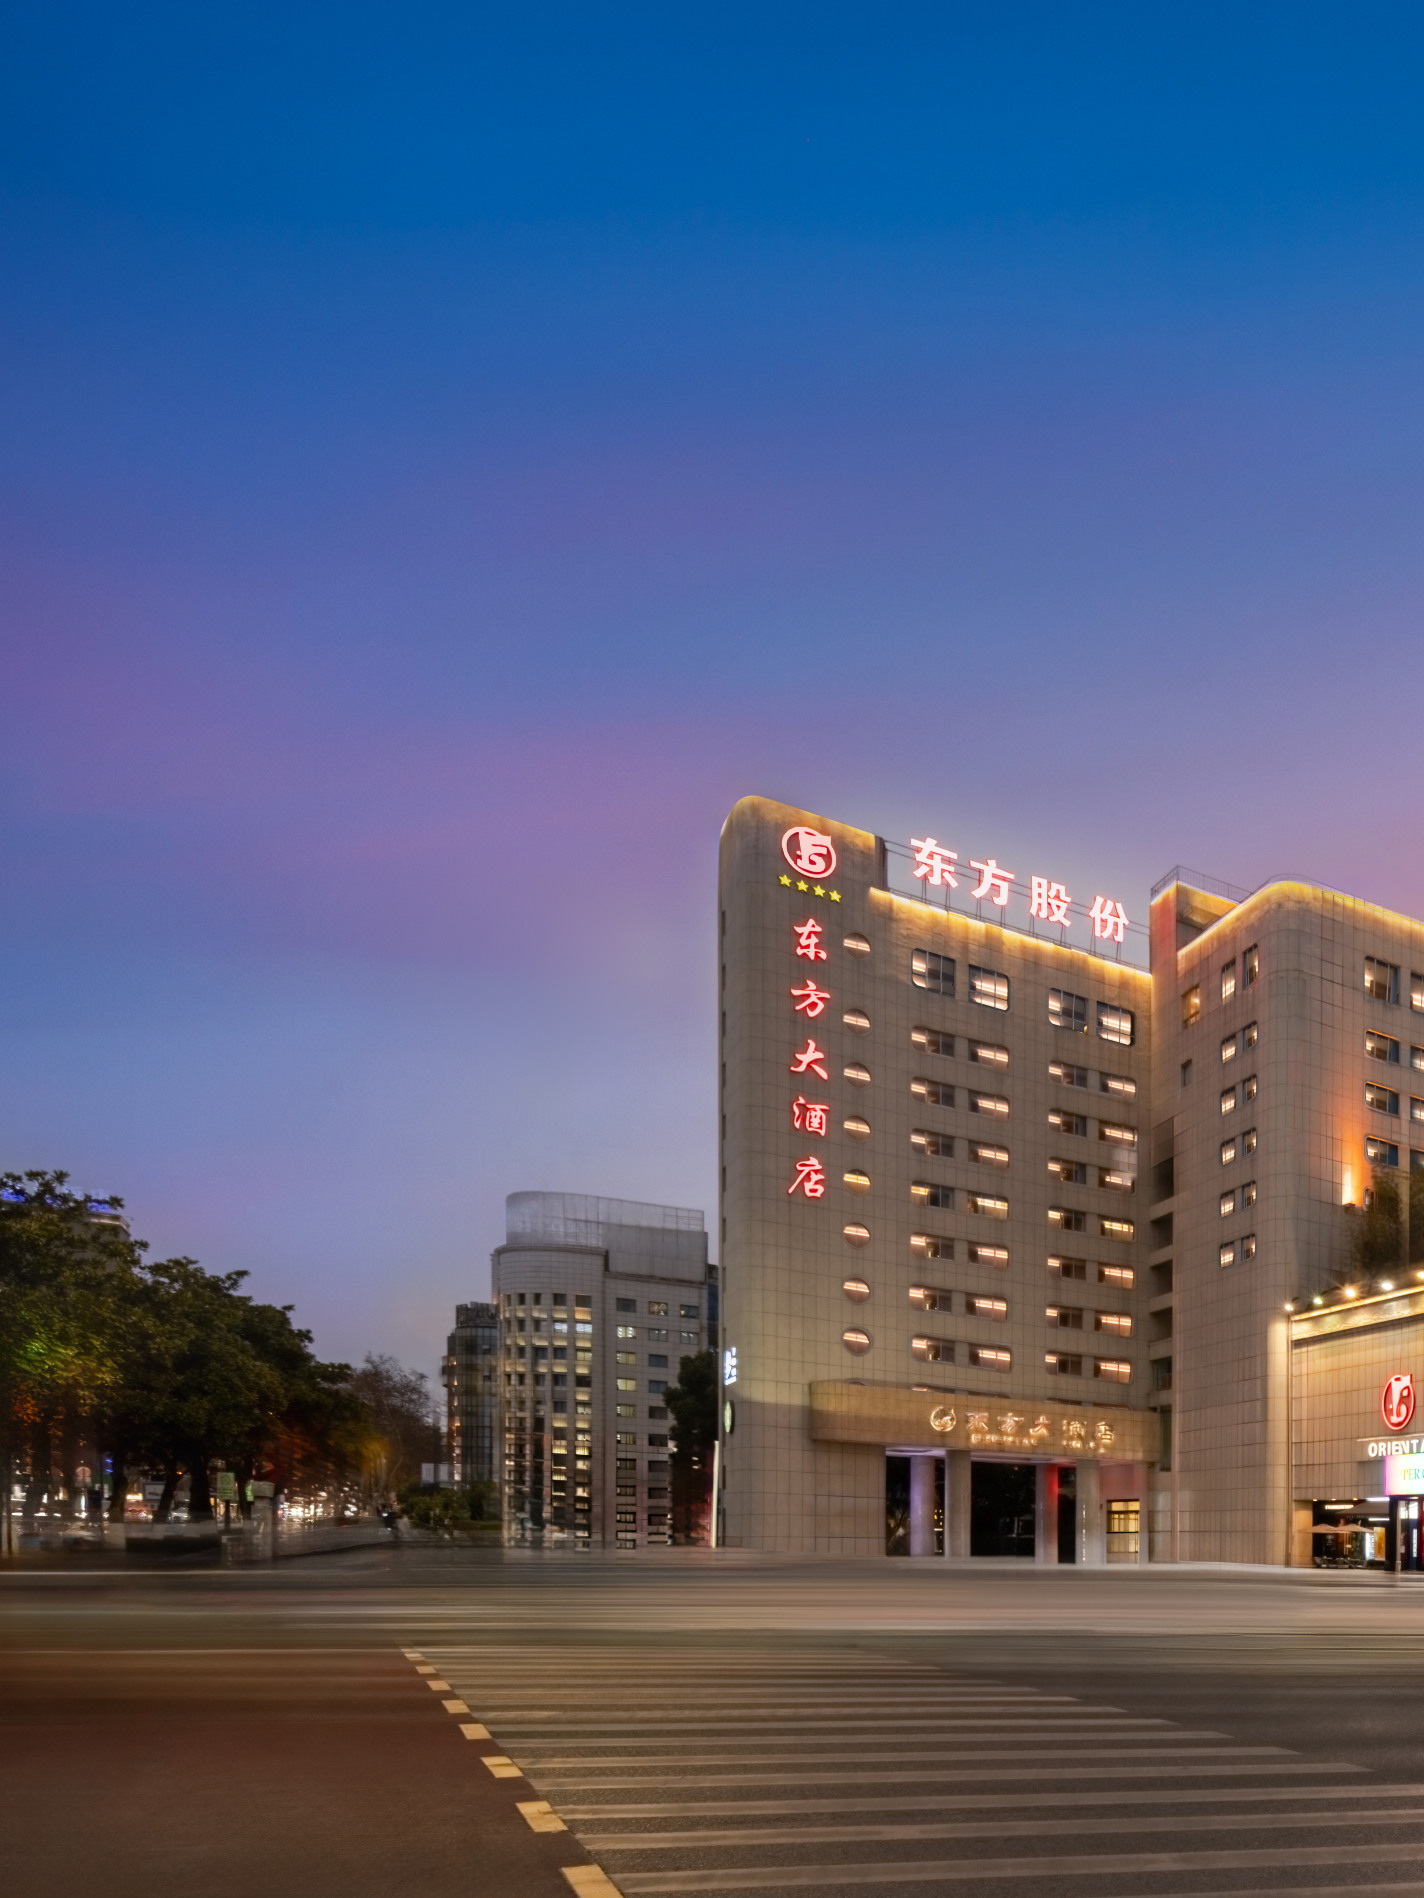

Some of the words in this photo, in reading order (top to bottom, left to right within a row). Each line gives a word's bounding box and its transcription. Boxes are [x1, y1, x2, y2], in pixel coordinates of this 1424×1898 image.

[909, 836, 1131, 943] 东方股份
[788, 917, 831, 1200] 东方大酒店
